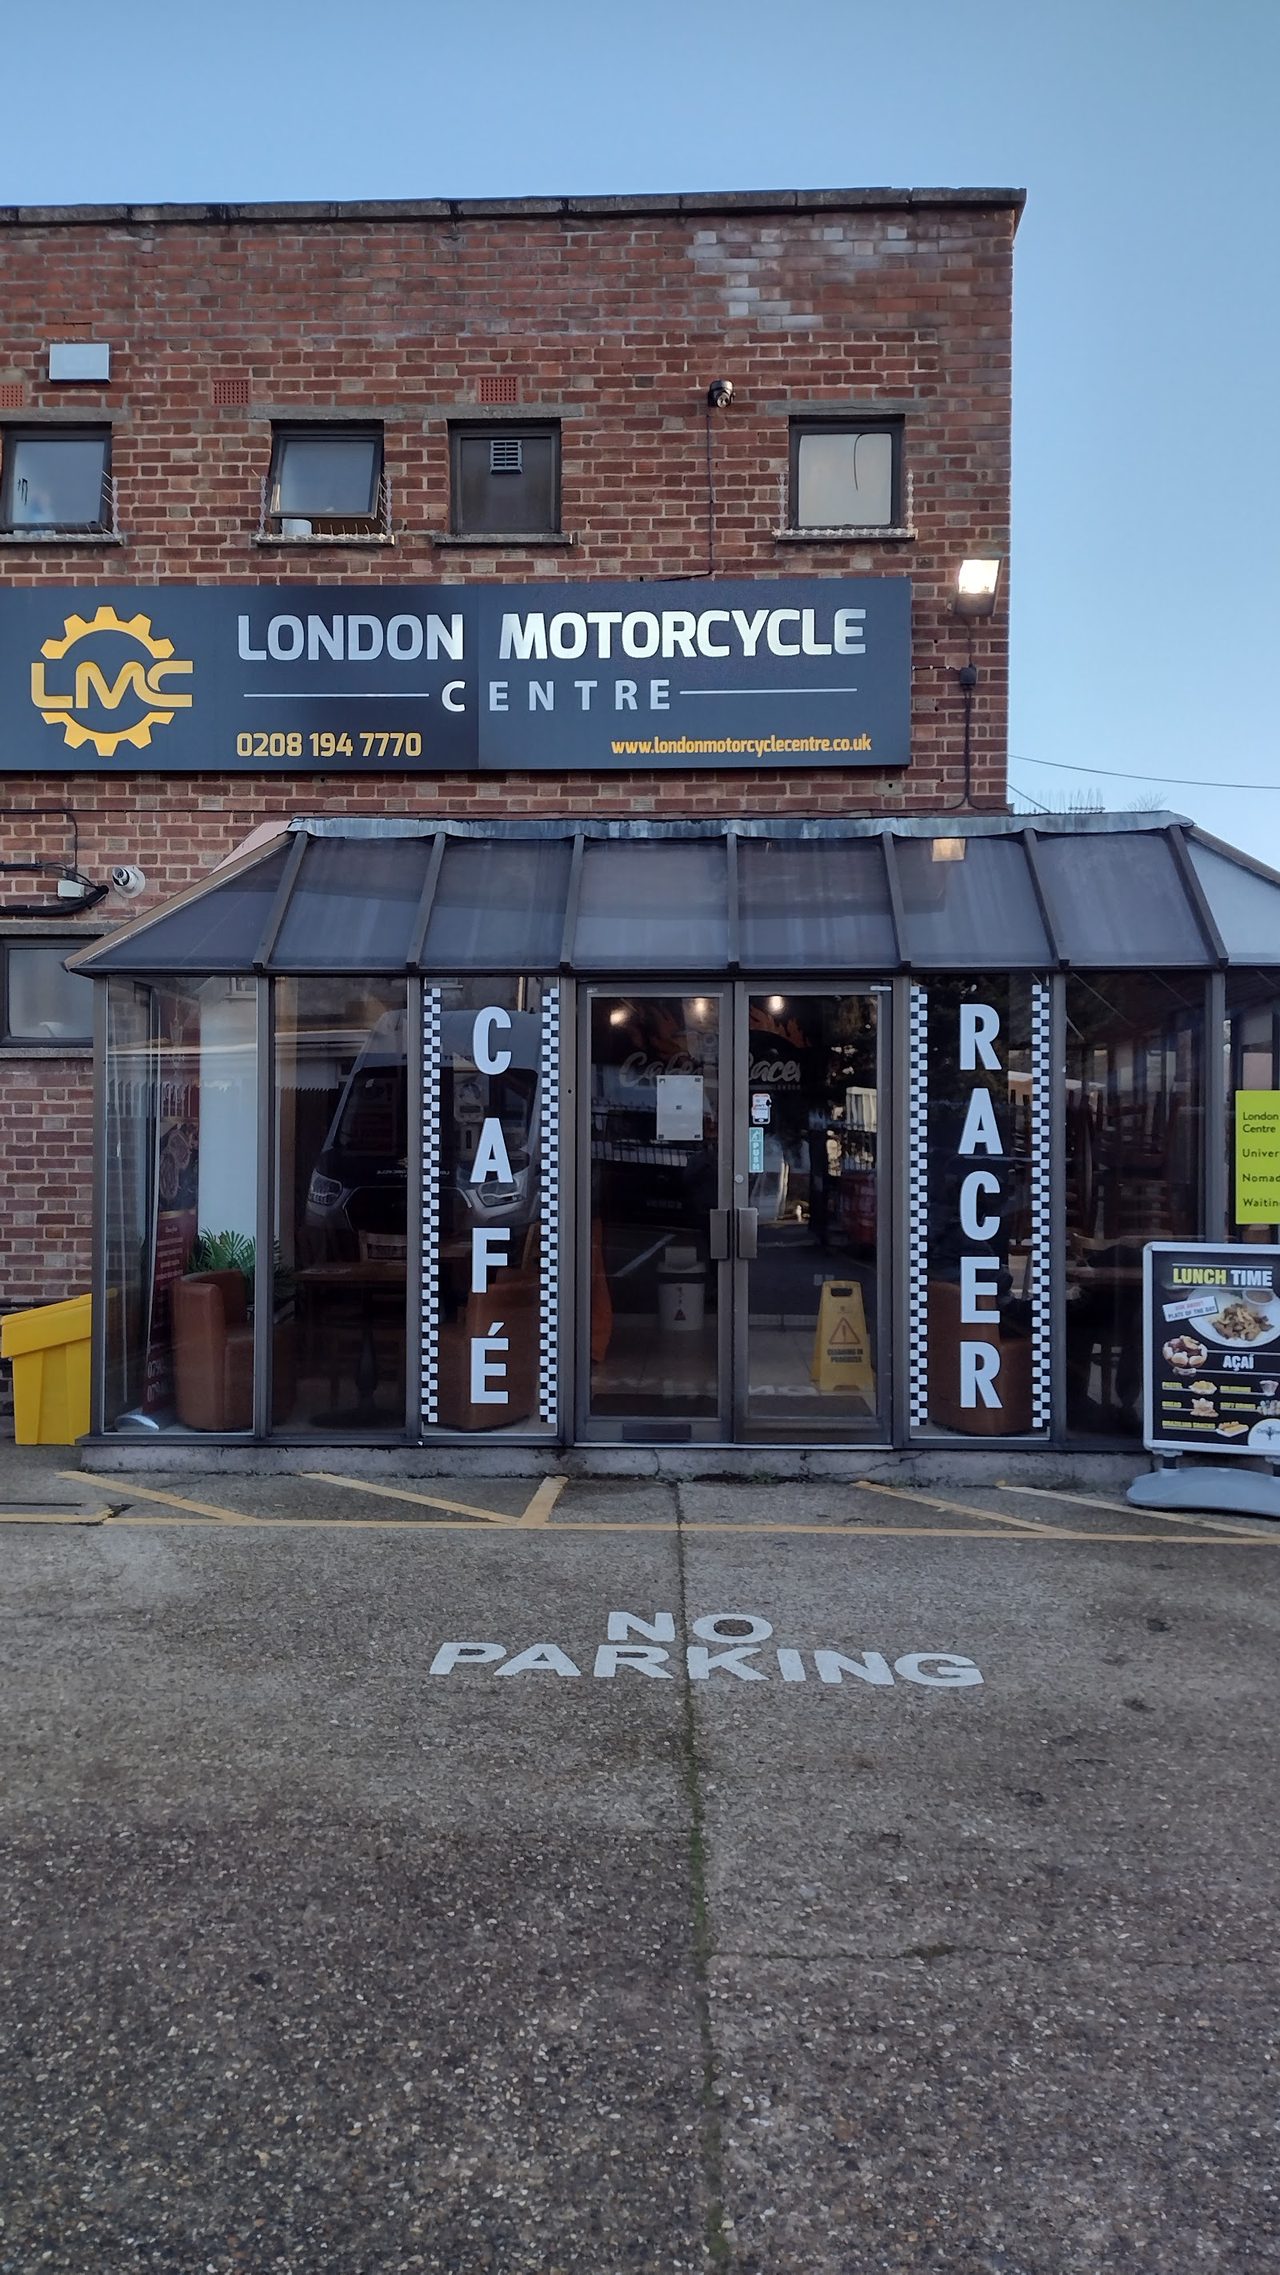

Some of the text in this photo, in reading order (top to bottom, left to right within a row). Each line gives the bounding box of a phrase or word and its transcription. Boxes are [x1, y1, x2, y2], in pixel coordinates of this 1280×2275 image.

[238, 608, 867, 661] LONDON MOTORCYCLE
[31, 660, 193, 709] LMC
[441, 679, 671, 712] CENTRE
[236, 732, 423, 757] 0208 194 7770
[611, 733, 872, 757] www.londonmotorcyclecentre.co.uk
[1242, 1112, 1279, 1121] London
[1242, 1124, 1276, 1133] Centre
[1242, 1148, 1279, 1158] Univer
[470, 1005, 514, 1404] CAFÉ
[957, 1003, 1004, 1409] RACER
[1243, 1198, 1280, 1207] Waitin
[1172, 1268, 1273, 1287] LUNCH TIME
[607, 1611, 774, 1645] NO
[429, 1641, 986, 1687] PARKING
